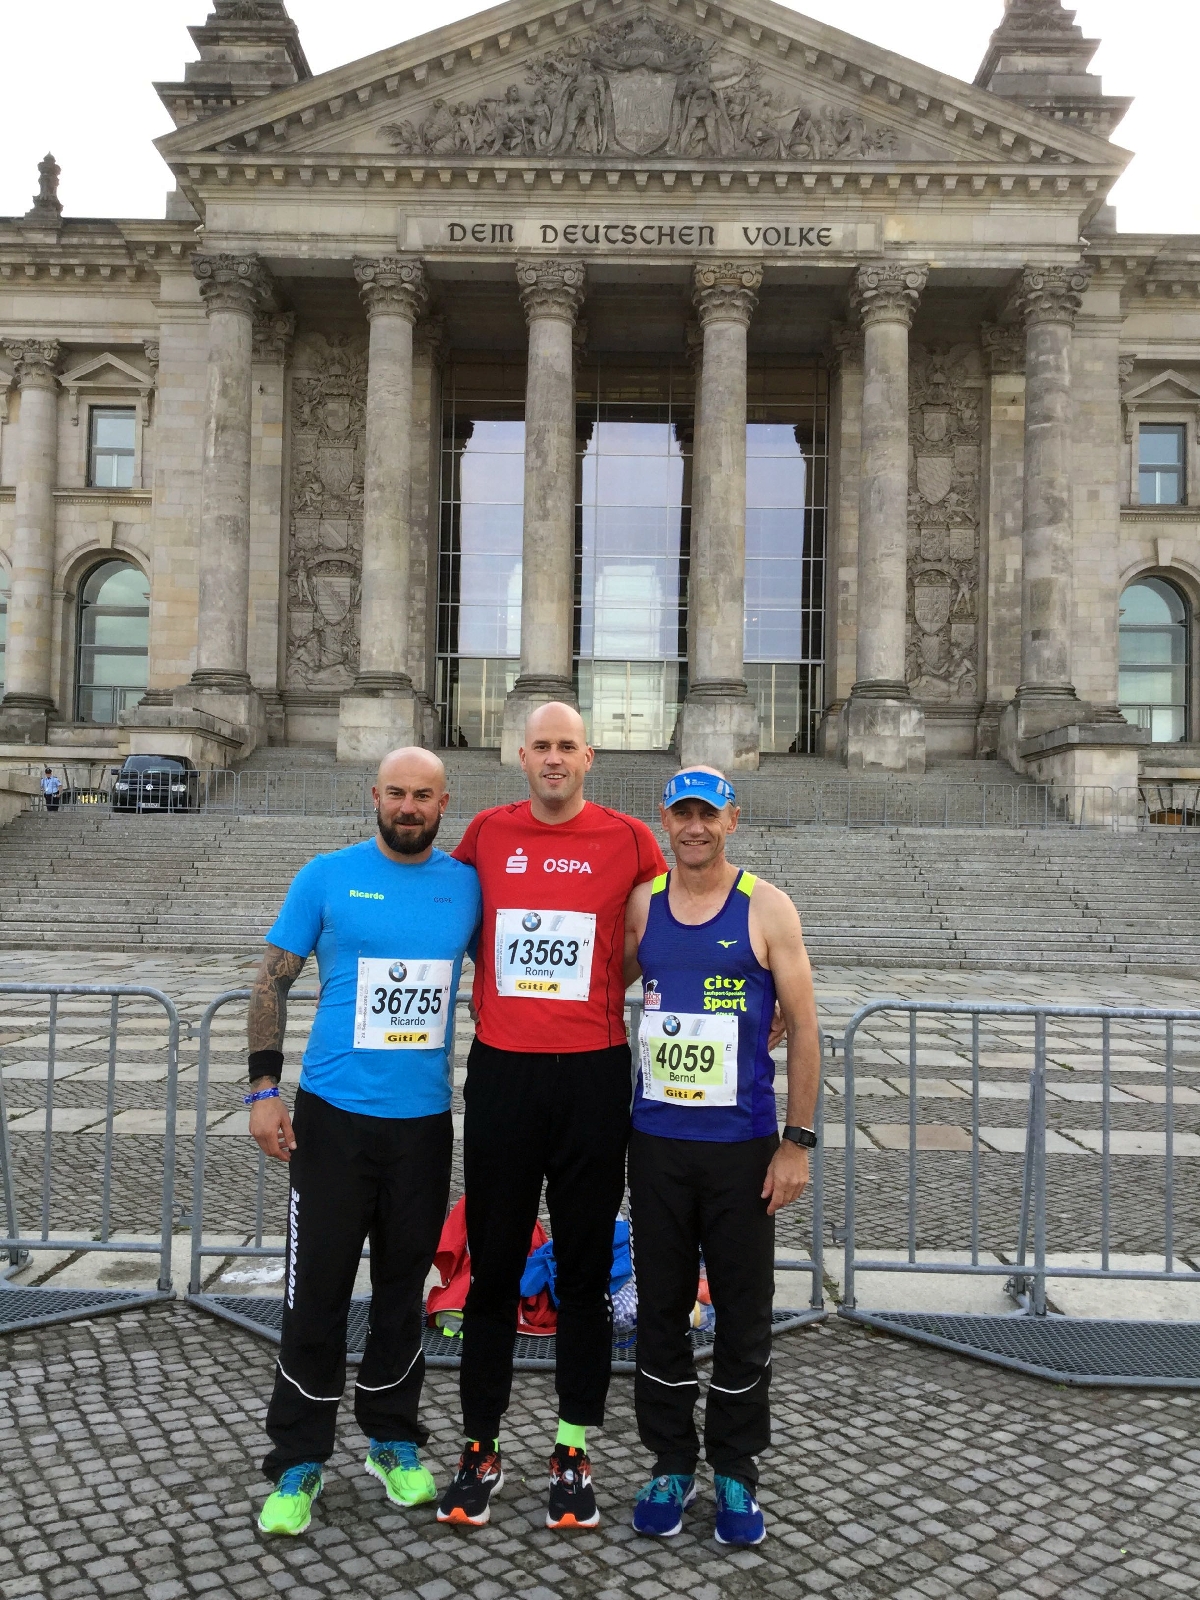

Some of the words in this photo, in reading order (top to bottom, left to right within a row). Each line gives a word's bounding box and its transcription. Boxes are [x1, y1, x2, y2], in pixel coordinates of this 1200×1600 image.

[448, 222, 514, 244] DEM
[540, 223, 715, 246] DEUTSCHEN
[742, 226, 833, 247] VOLKE
[543, 858, 592, 874] OSPA
[349, 889, 385, 900] Ricardo
[507, 938, 579, 967] 13563
[582, 939, 590, 947] H
[525, 966, 555, 979] Ronny
[518, 982, 543, 991] Giti
[703, 974, 746, 991] City
[371, 987, 443, 1015] 36755
[703, 996, 748, 1012] Sport
[390, 1016, 426, 1026] Ricardo
[387, 1034, 413, 1042] Giti
[655, 1042, 715, 1073] 4059
[669, 1072, 696, 1083] Bernd
[666, 1089, 688, 1099] Giti
